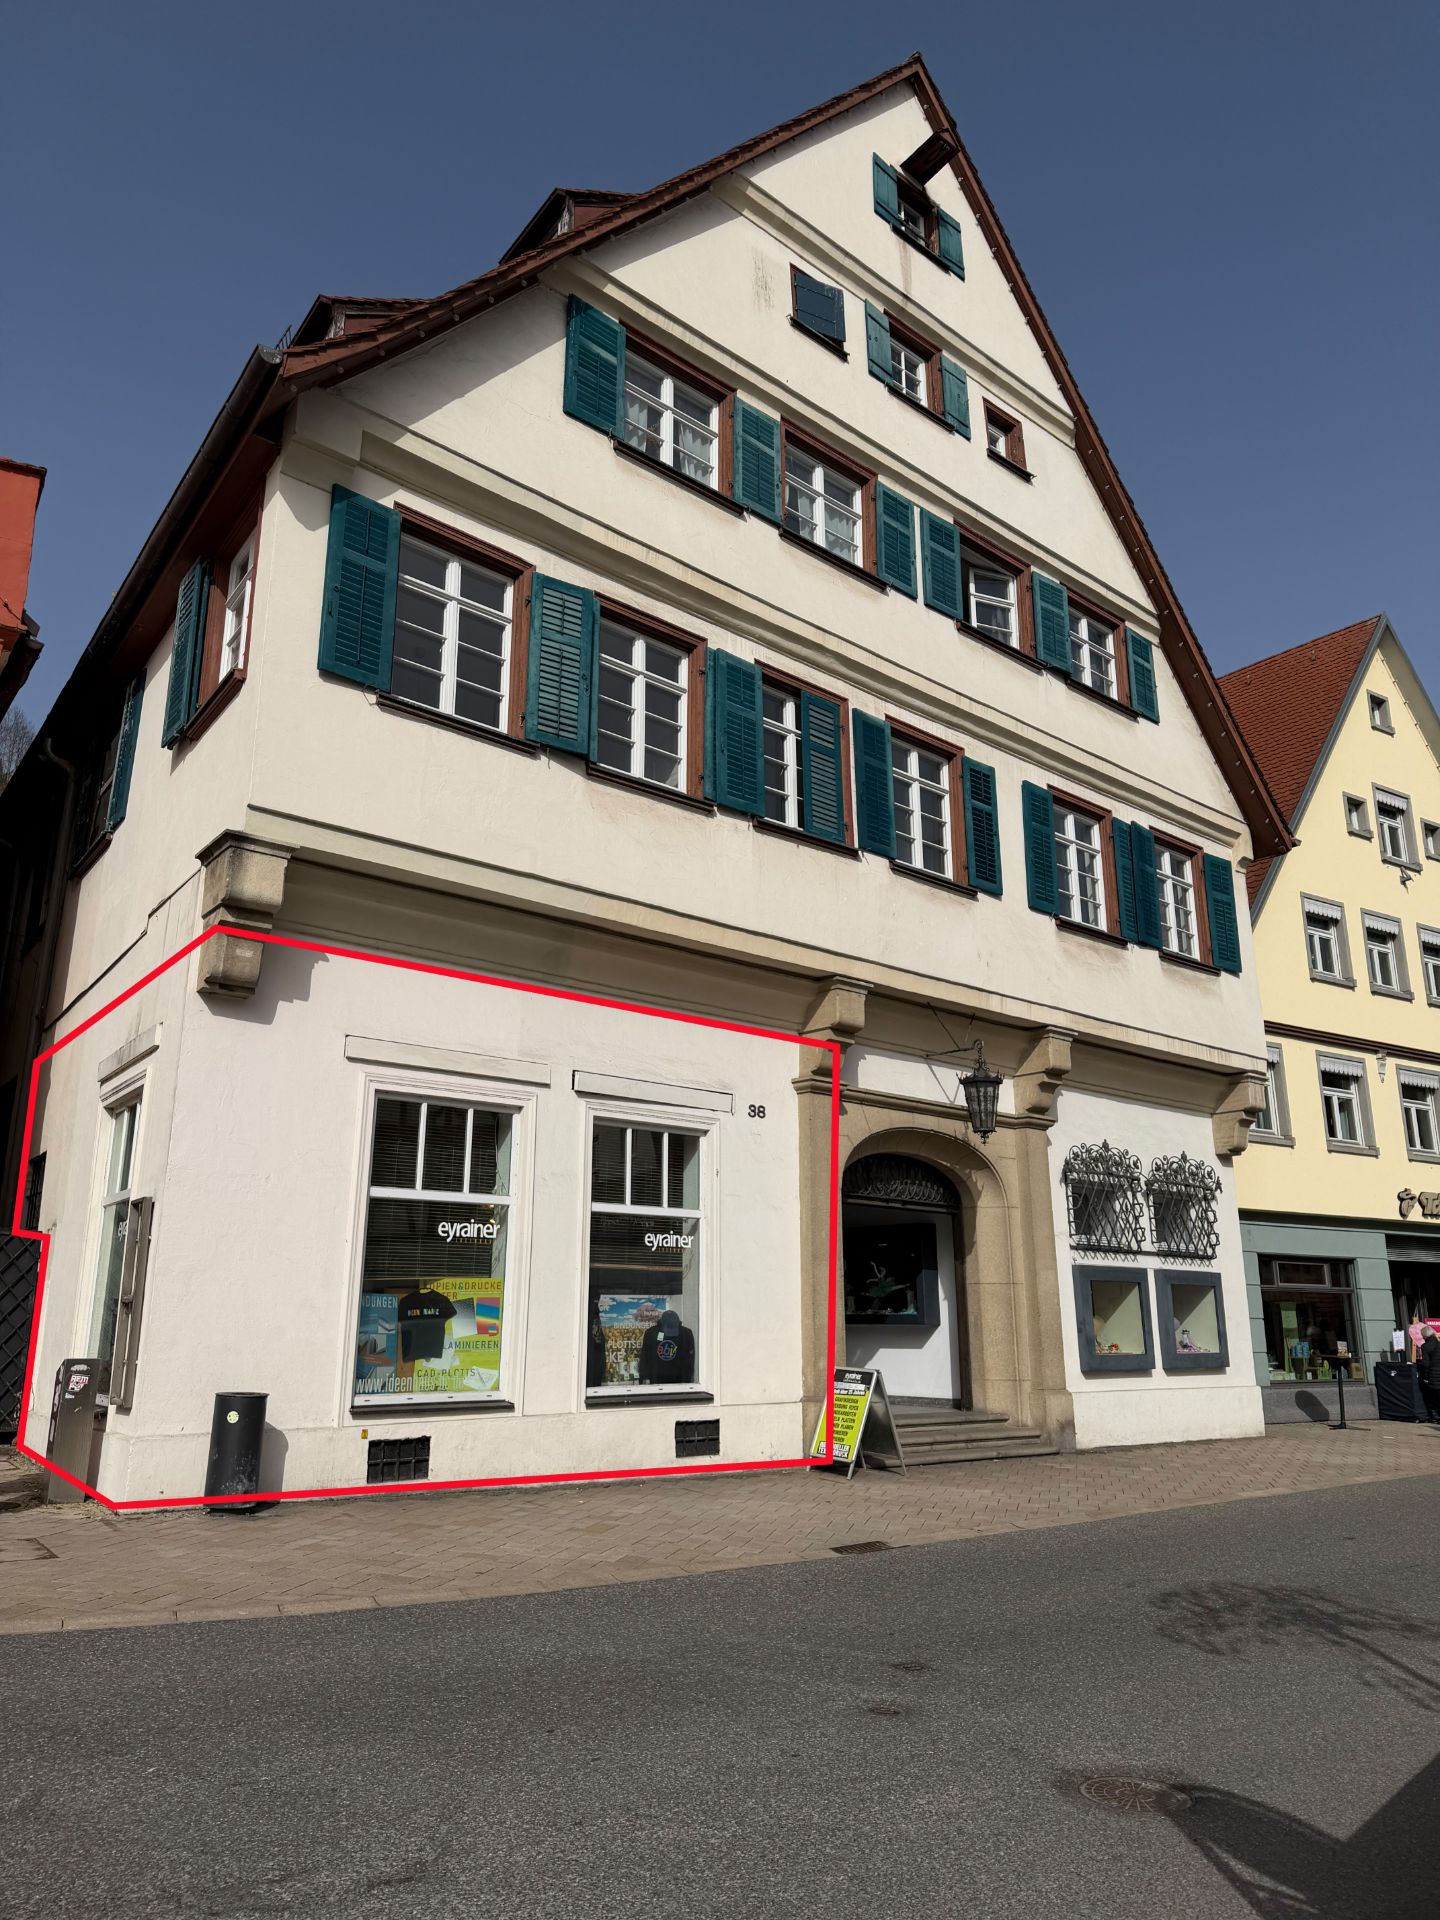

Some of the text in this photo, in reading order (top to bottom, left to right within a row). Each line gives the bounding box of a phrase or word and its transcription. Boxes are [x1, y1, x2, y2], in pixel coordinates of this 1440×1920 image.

[747, 1103, 767, 1119] 38
[437, 1219, 501, 1243] eyrainer
[644, 1230, 694, 1251] eyrainer
